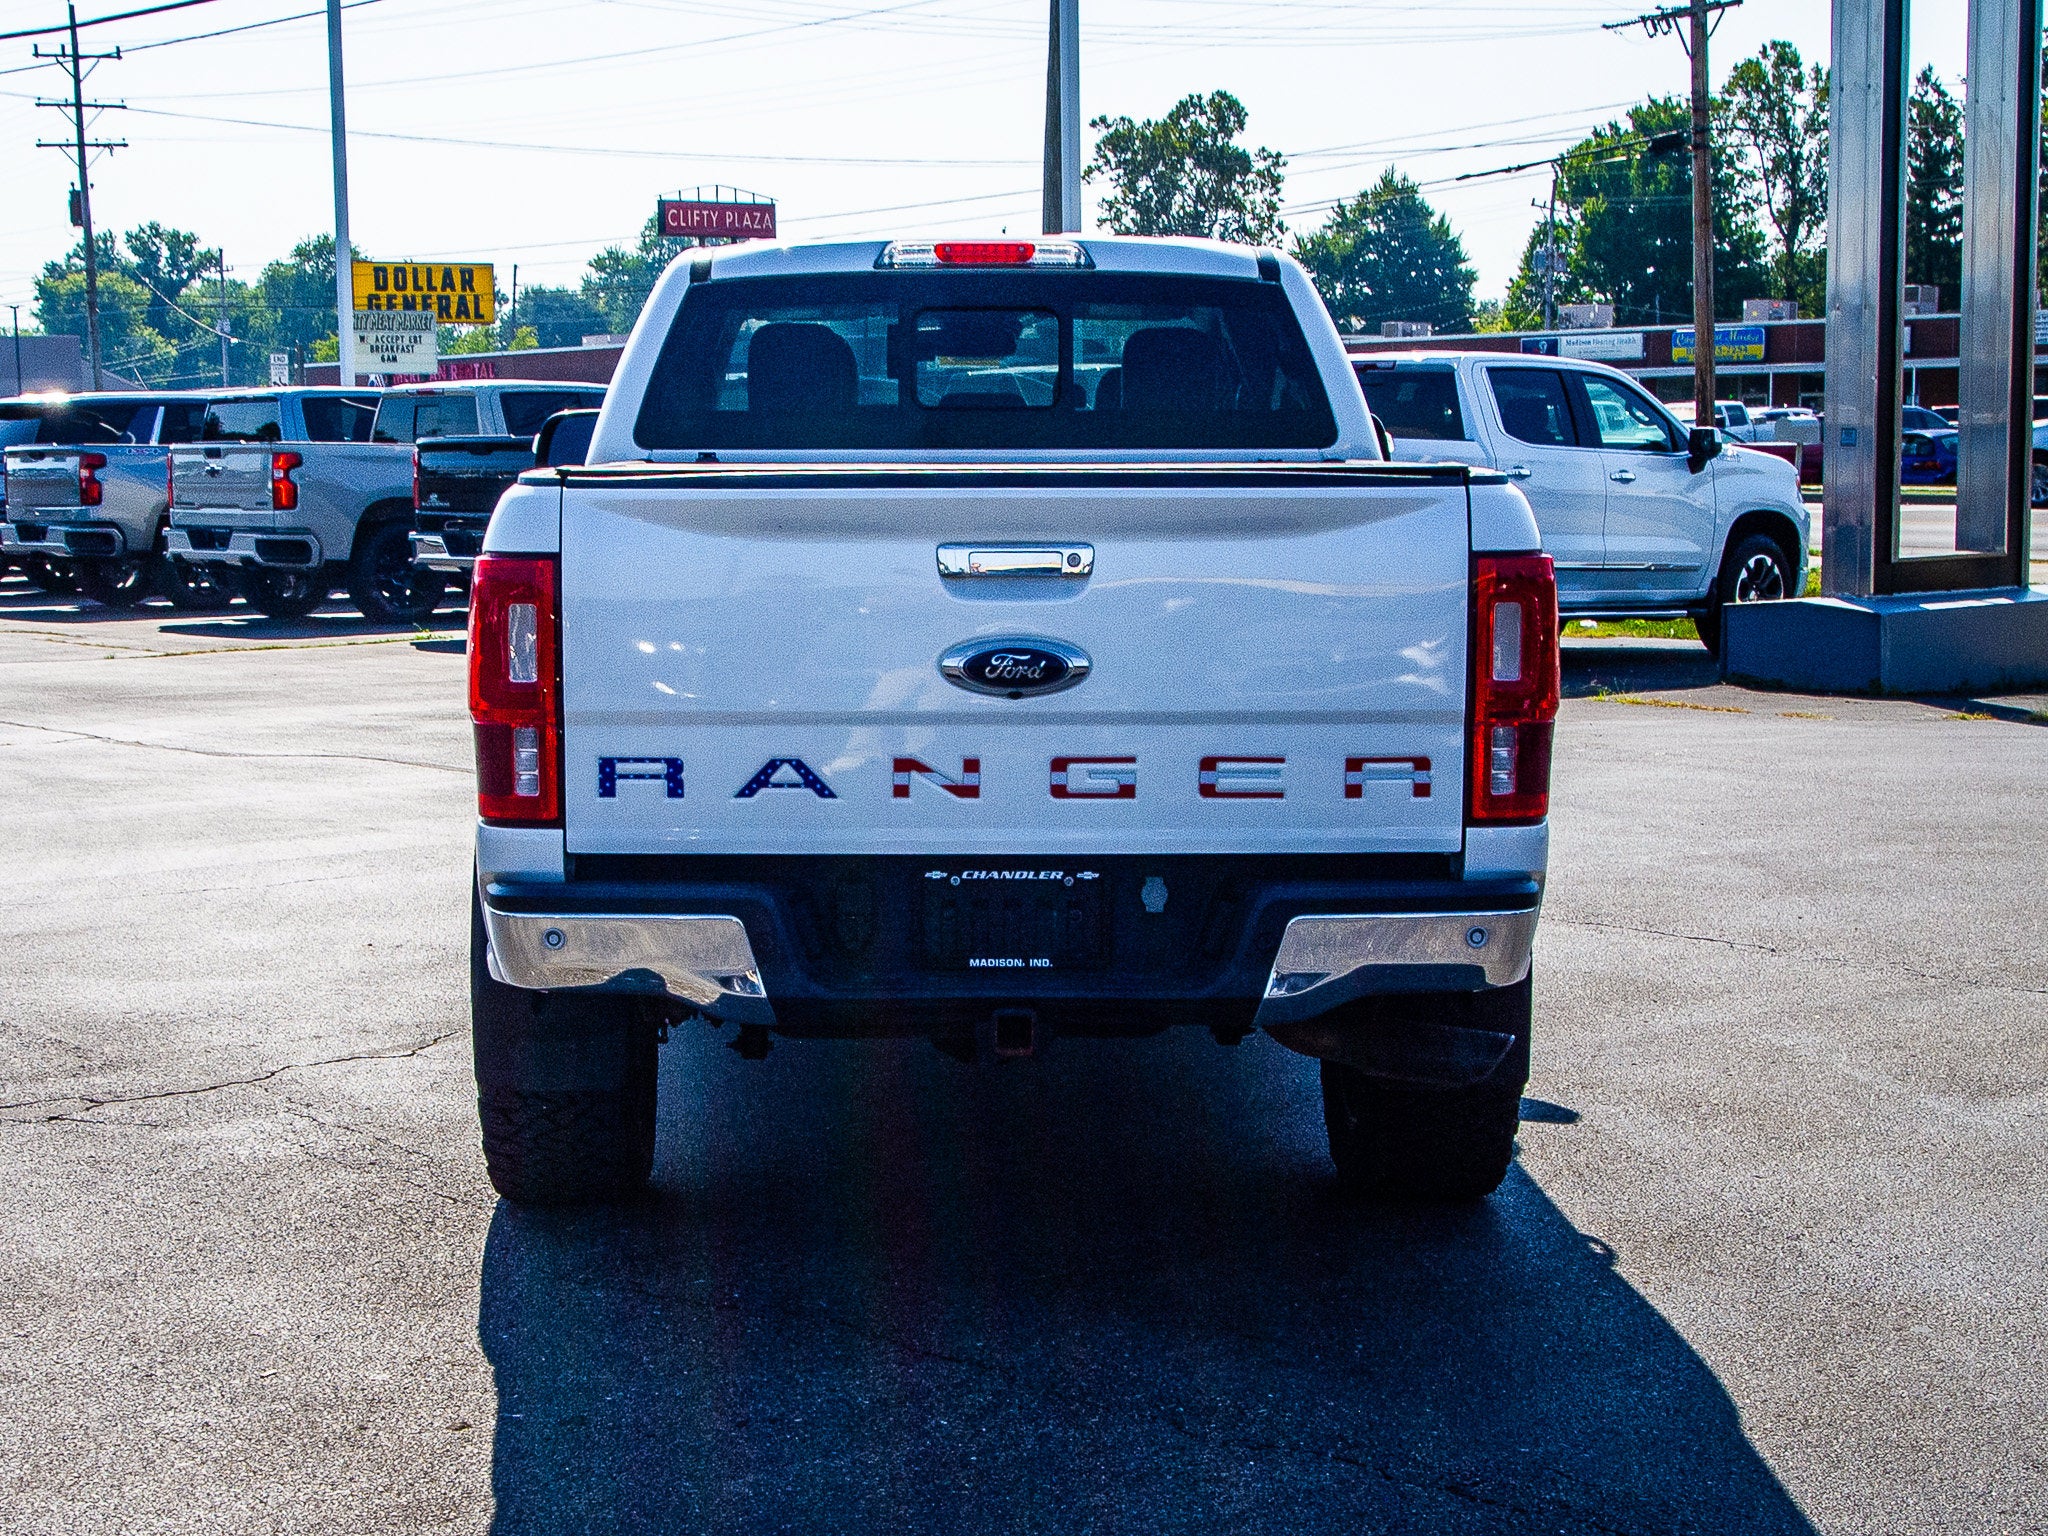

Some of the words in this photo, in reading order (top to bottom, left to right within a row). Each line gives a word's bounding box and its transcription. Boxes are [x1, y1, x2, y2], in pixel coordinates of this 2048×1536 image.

[668, 209, 719, 228] CLIFTY
[725, 211, 772, 229] PLAZA
[373, 266, 475, 292] DOLLAR
[367, 294, 485, 320] GENERAL
[353, 312, 369, 331] ITY
[369, 312, 396, 331] MEAT
[396, 312, 434, 331] MARKET
[370, 344, 415, 353] BREAKFAST
[374, 335, 405, 344] ACCEPT
[408, 335, 422, 344] EBT
[1565, 339, 1592, 347] Madison
[450, 363, 495, 380] RENTAL
[985, 653, 1046, 679] Ford
[599, 757, 1431, 799] RANGER
[961, 870, 1064, 880] CHANDLER
[1029, 958, 1053, 968] IND.
